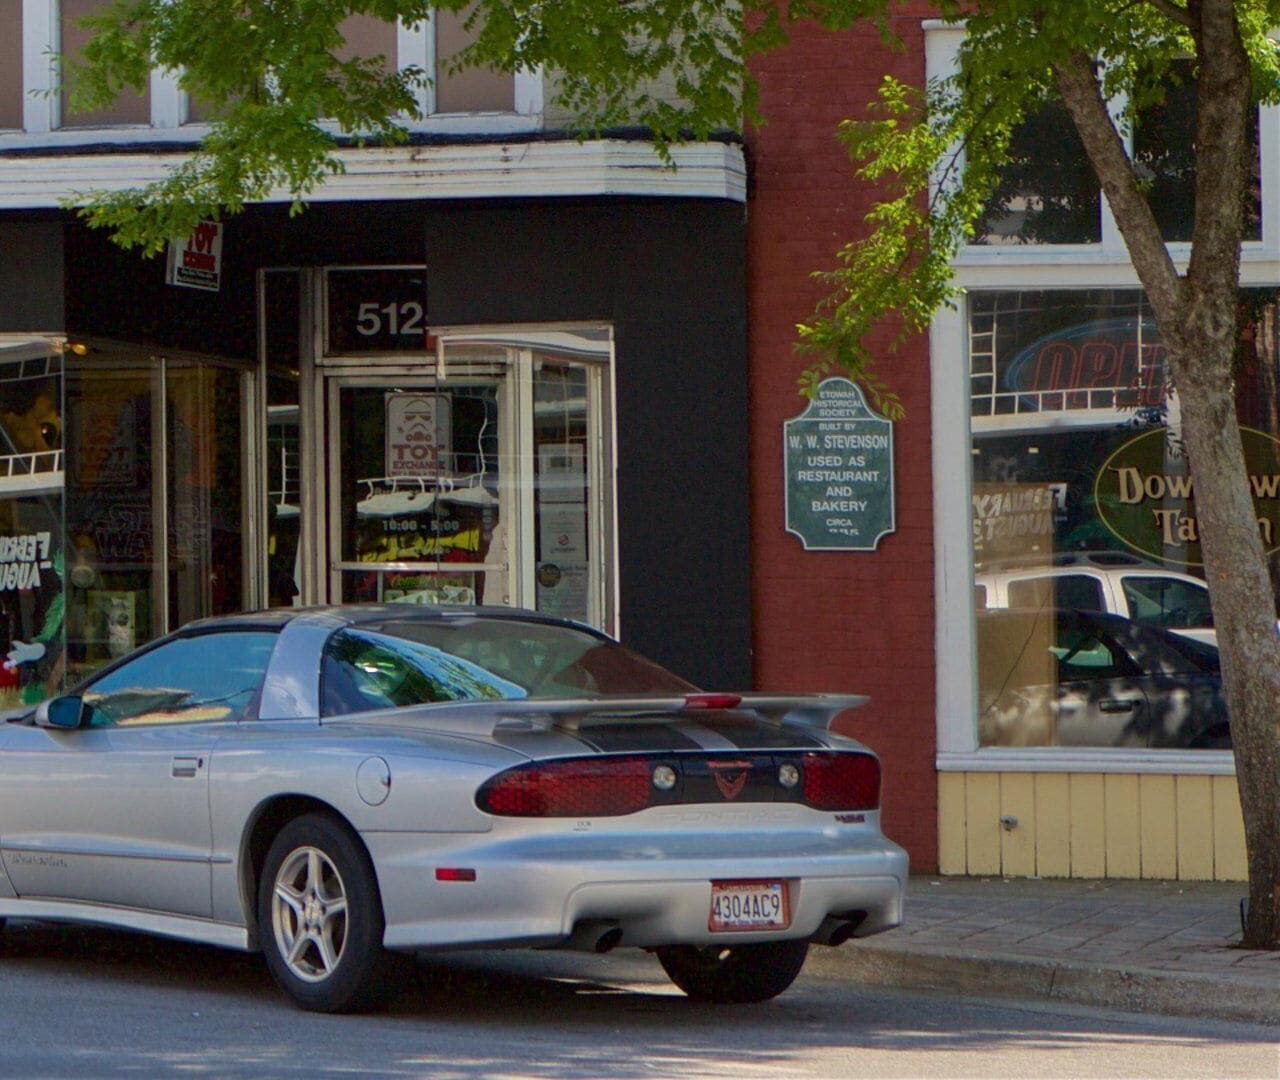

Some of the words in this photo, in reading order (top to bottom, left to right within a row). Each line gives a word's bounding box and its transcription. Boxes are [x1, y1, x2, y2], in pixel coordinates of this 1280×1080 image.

[356, 302, 423, 336] 512
[819, 391, 856, 399] ETOWAH
[814, 400, 863, 408] HISTORICAL
[819, 409, 856, 417] SOCIETY
[819, 423, 842, 431] BUILT
[845, 423, 856, 431] BY
[789, 435, 803, 449] W.
[806, 435, 820, 449] W.
[824, 435, 888, 449] STEVENSON
[391, 444, 445, 460] TOY
[807, 456, 842, 467] USED
[847, 456, 866, 467] AS
[798, 471, 879, 482] RESTAURANT
[826, 486, 852, 497] AND
[811, 501, 868, 512] BAKERY
